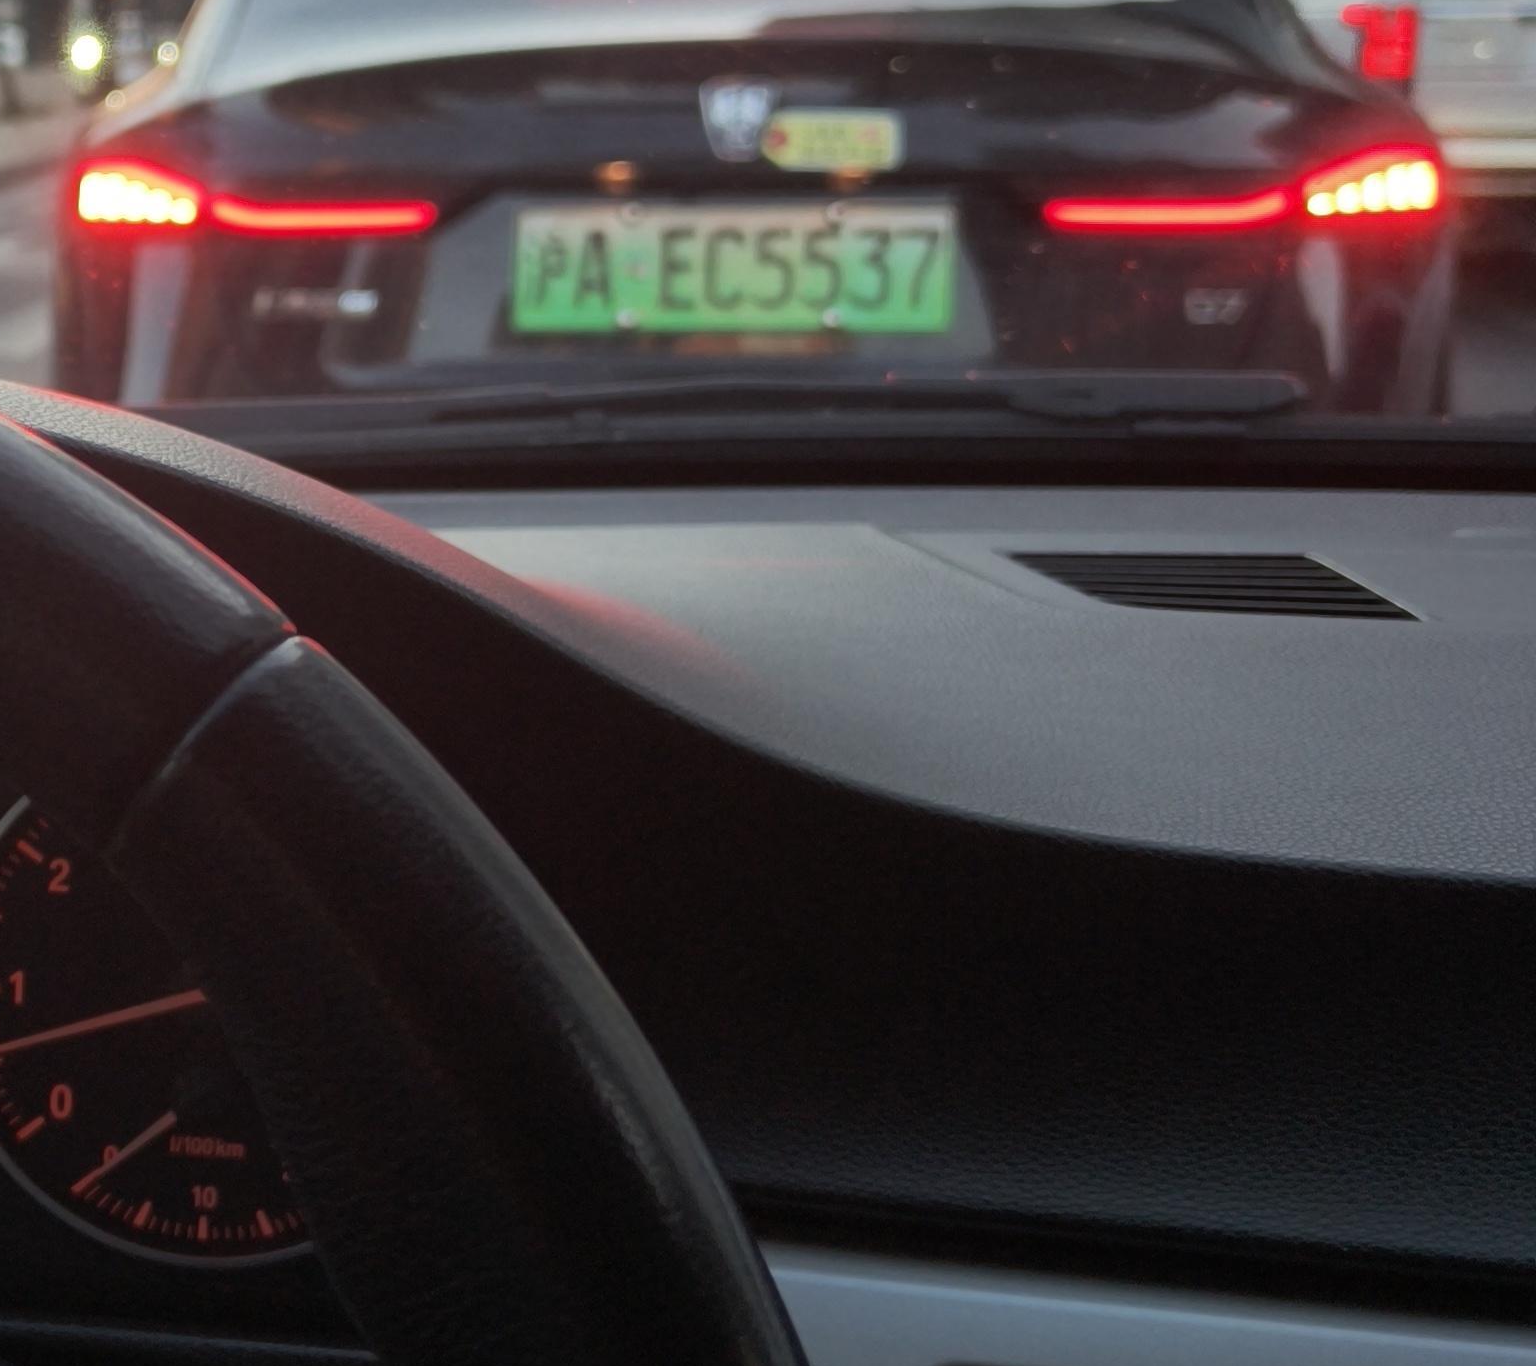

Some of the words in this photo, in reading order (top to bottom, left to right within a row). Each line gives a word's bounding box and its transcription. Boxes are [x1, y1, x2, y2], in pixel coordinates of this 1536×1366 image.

[657, 227, 941, 311] EC5537
[48, 859, 71, 894] 2
[10, 972, 25, 1005] 1
[49, 1084, 73, 1120] 0
[192, 1185, 218, 1209] 10
